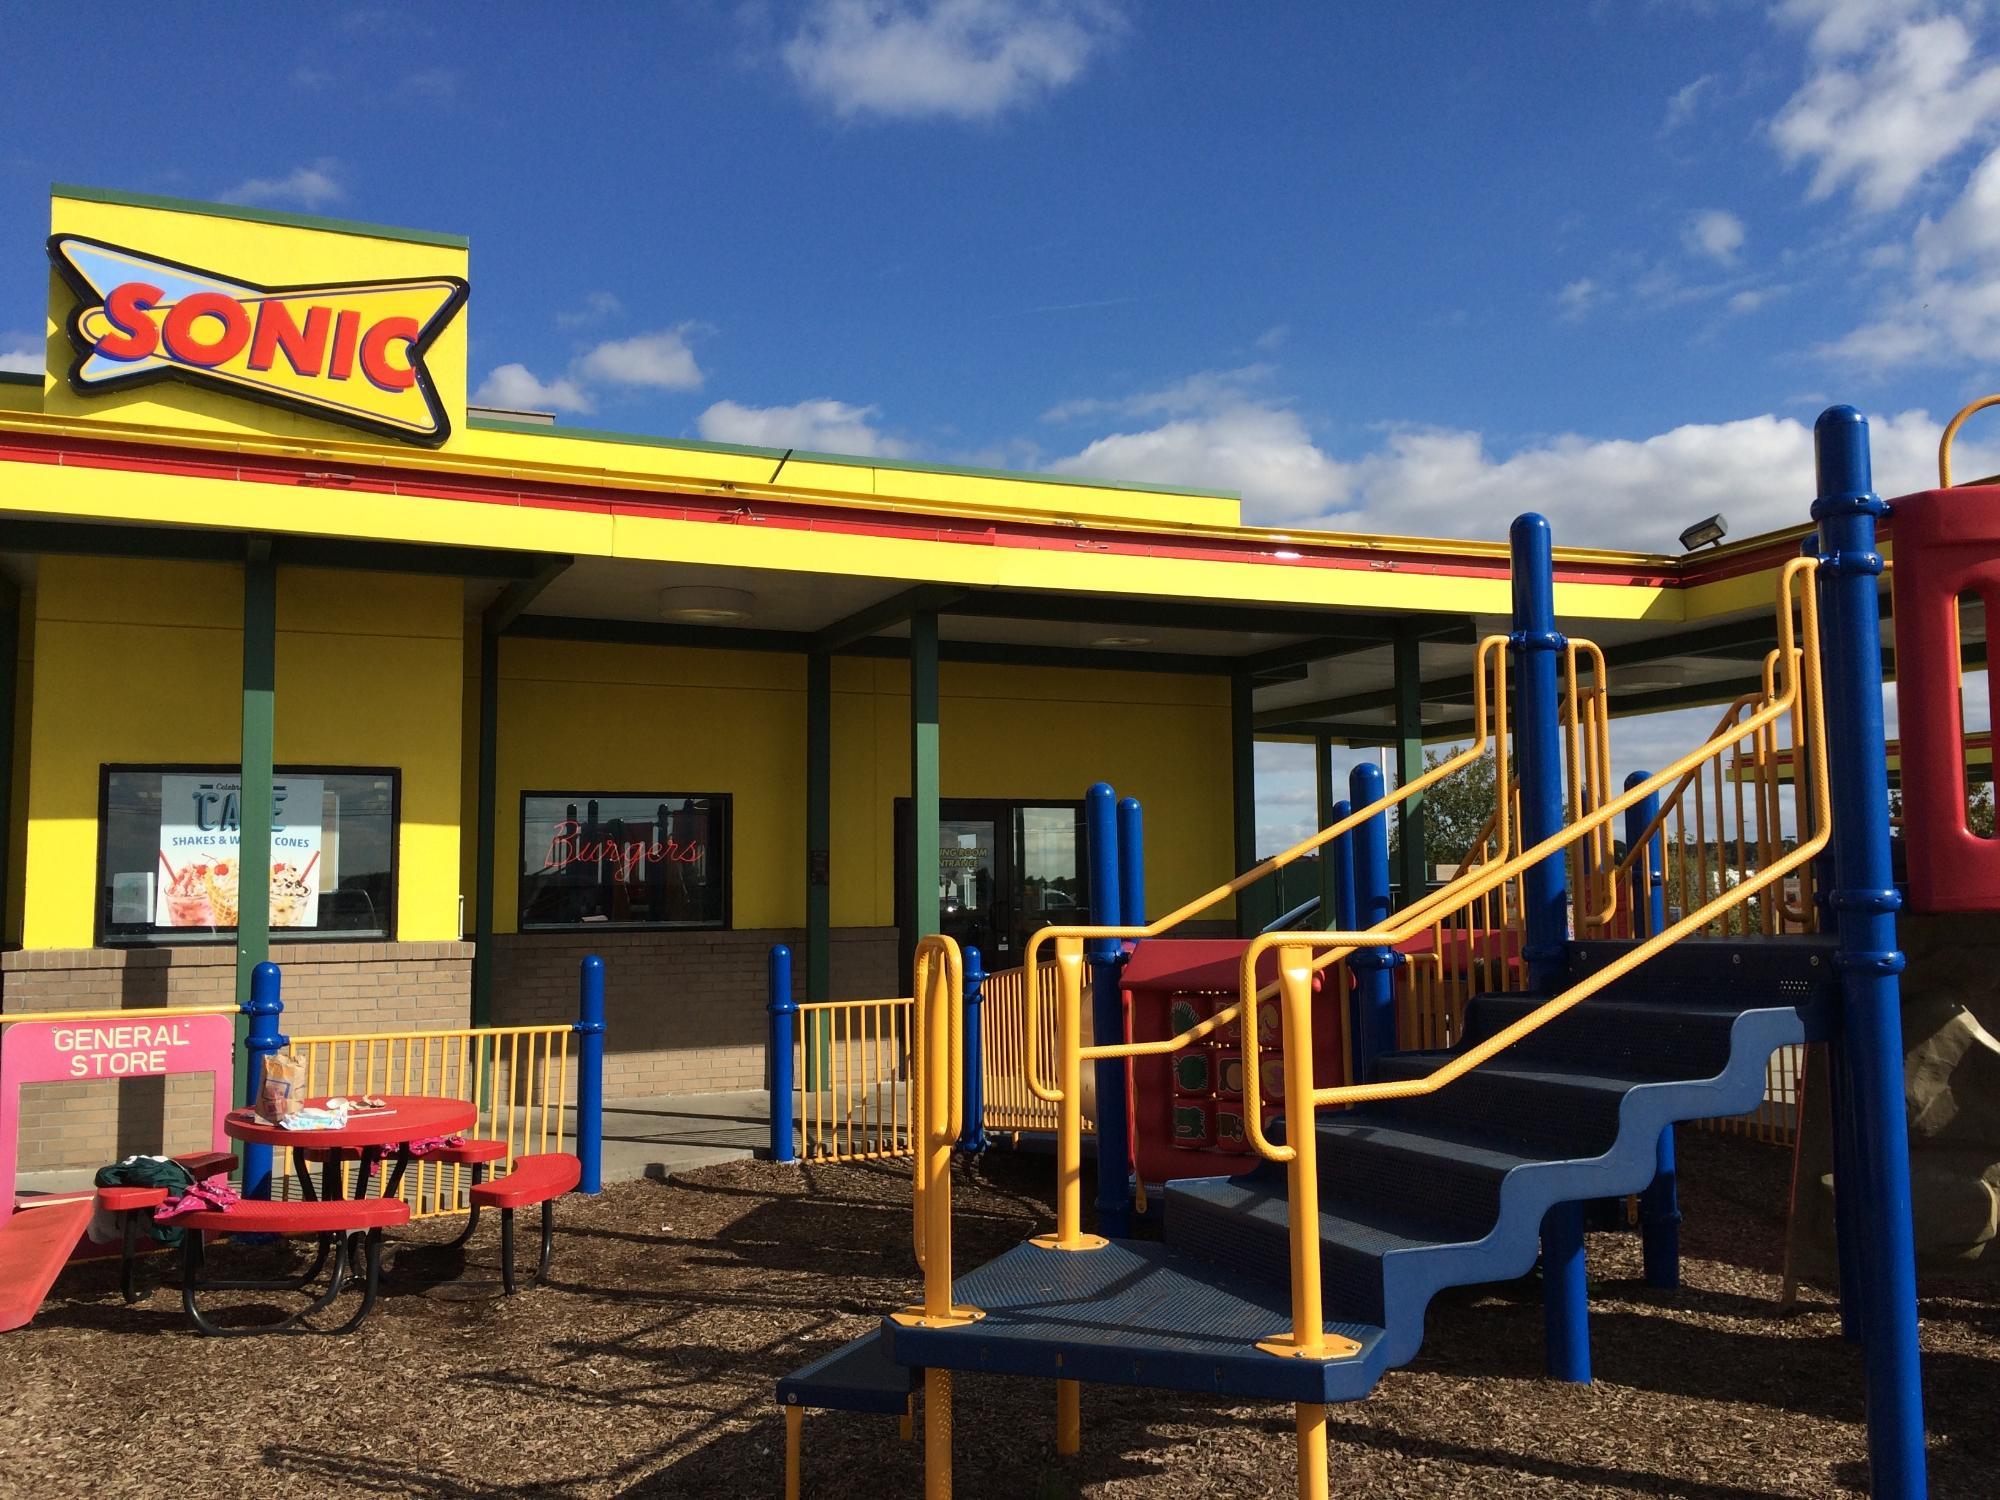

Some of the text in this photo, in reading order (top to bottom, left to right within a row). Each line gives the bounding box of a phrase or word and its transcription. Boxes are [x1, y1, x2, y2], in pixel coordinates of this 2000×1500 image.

[94, 282, 419, 392] SONIC
[216, 782, 241, 790] Celebr
[192, 792, 288, 832] CAE
[172, 835, 216, 847] SHAKES
[218, 835, 227, 845] &
[274, 837, 310, 848] CONES
[543, 819, 704, 882] Burgers
[939, 847, 988, 857] ING ROOM
[939, 859, 979, 868] NTRANCE
[54, 1024, 190, 1052] GENERAL
[70, 1050, 167, 1077] STORE
